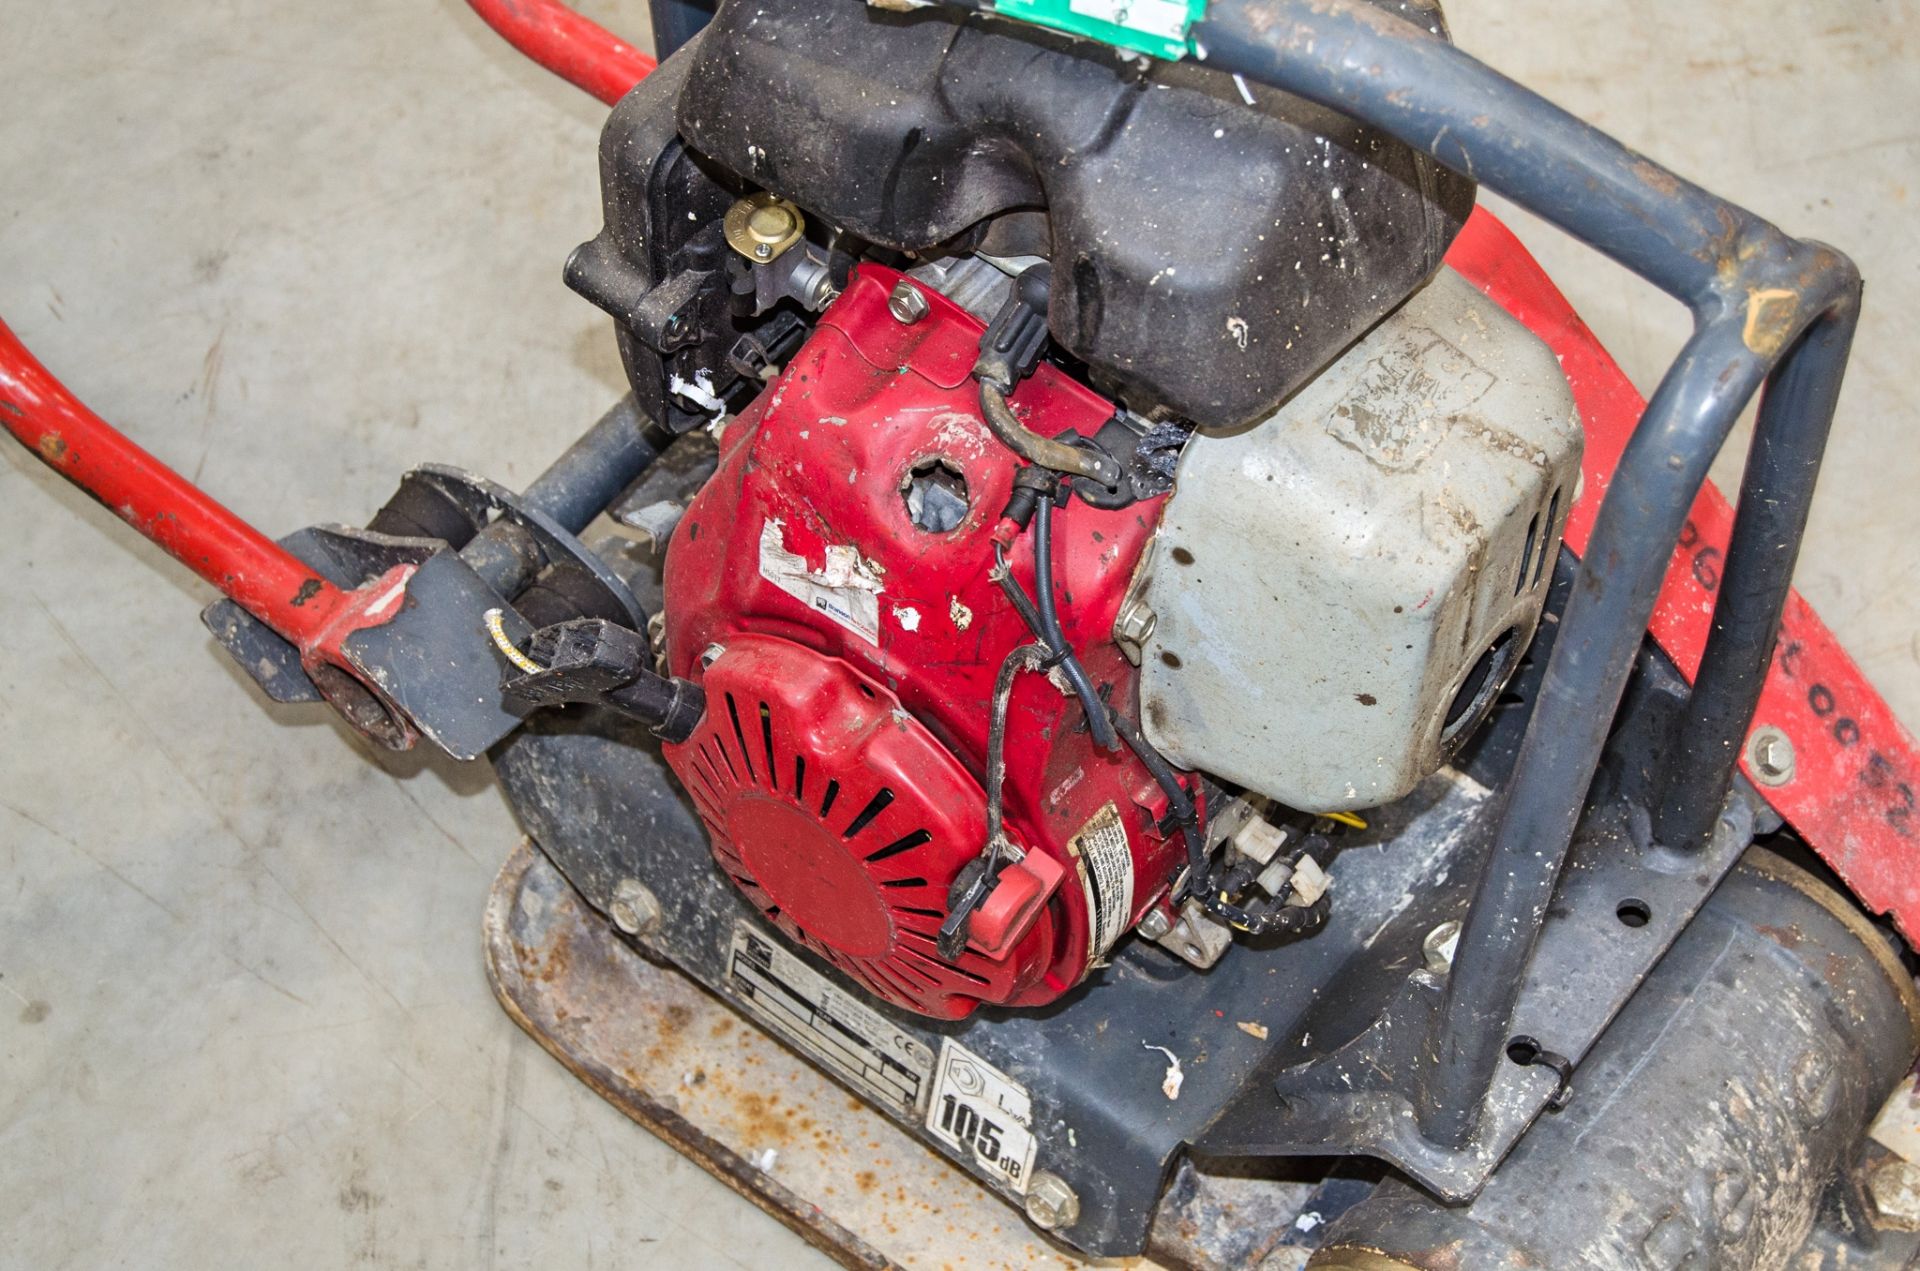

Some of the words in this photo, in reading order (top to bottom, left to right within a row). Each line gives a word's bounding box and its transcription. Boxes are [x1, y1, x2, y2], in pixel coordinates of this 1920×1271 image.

[894, 1035, 914, 1055] CE
[943, 1093, 1004, 1163] 105
[1001, 1155, 1022, 1179] dB
